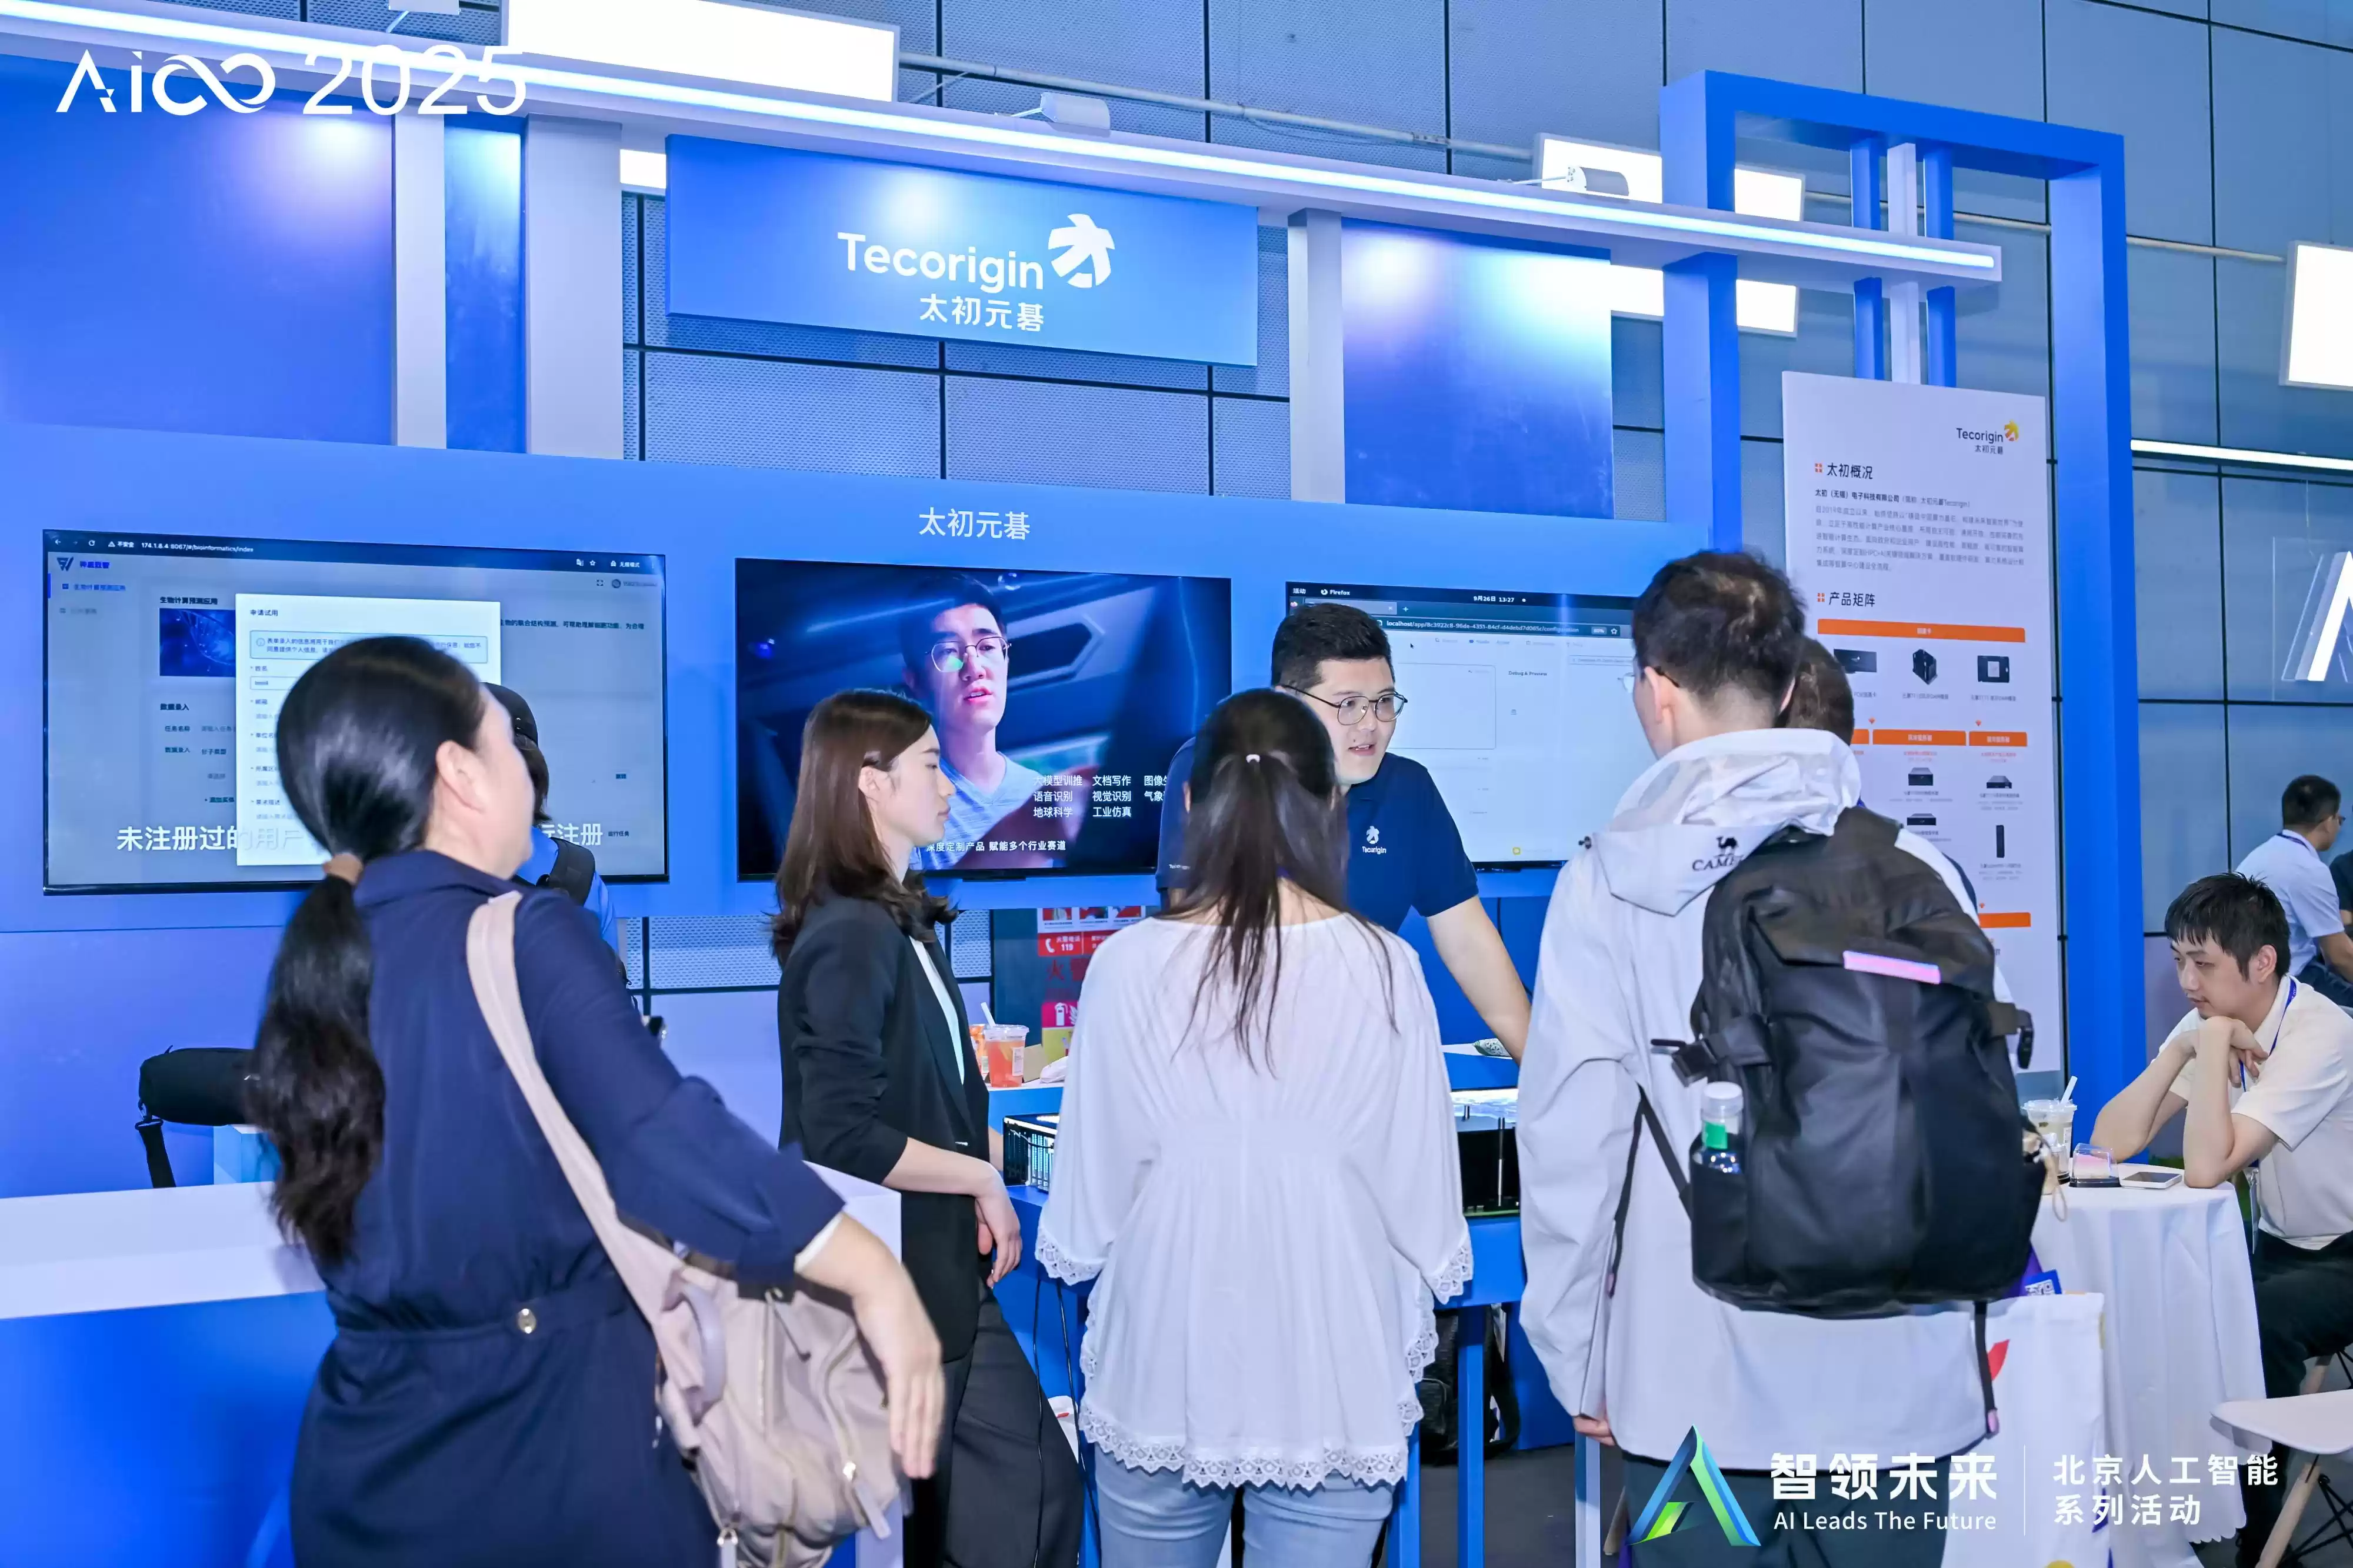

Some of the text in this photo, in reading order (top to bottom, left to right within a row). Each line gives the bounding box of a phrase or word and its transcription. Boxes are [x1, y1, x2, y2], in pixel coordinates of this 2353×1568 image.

[838, 232, 1044, 293] Tecorigin
[919, 293, 1044, 332] 太初元碁
[1956, 428, 2004, 443] Tecorigin
[1827, 463, 1873, 479] 太初概况
[919, 508, 1031, 541] 太初元碁
[1828, 591, 1875, 608] 产品矩阵
[1033, 775, 1083, 787] 大模型训推
[1092, 775, 1132, 787] 文档写作
[1033, 790, 1164, 802] 语音识别 视觉识别 气象
[1033, 806, 1132, 818] 地球科学 工业仿真
[926, 840, 1066, 852] 深度定制产品 赋能多个行业赛道
